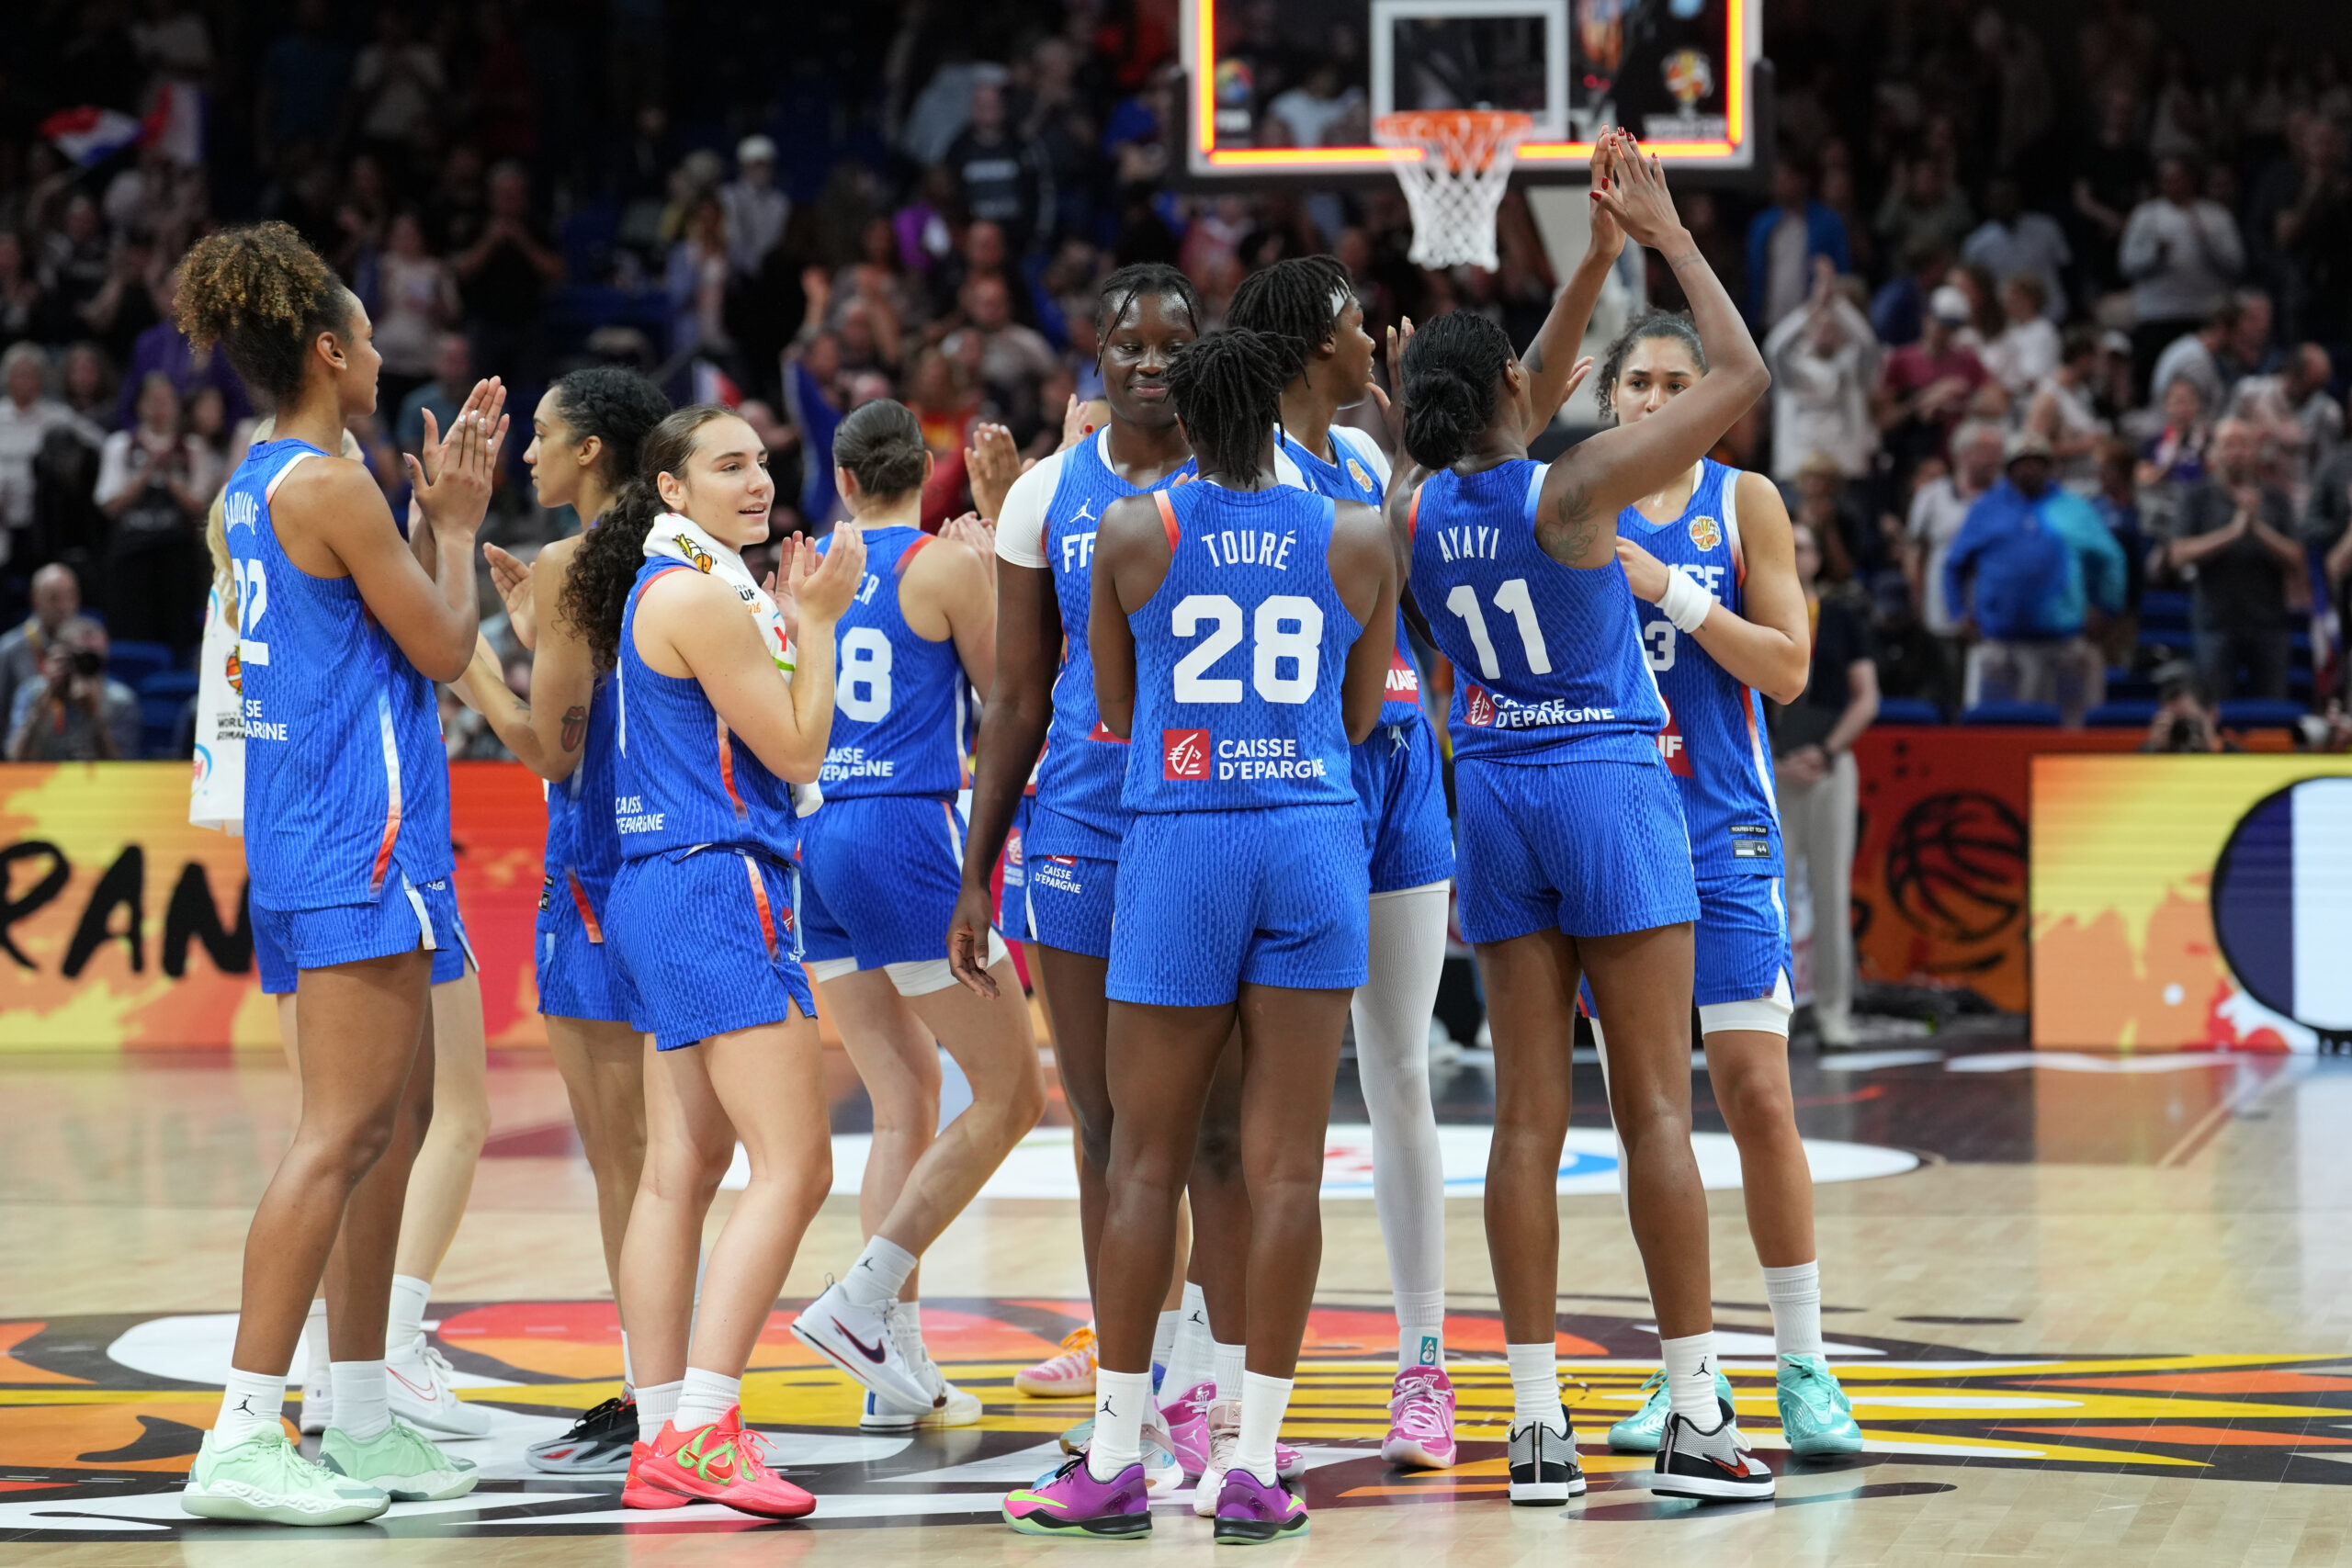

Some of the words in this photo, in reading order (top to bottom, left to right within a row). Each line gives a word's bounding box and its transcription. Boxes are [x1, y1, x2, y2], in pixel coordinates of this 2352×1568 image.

[1201, 530, 1296, 571] TOURÉ
[1438, 525, 1499, 563] AYAYI
[1446, 578, 1552, 680] 11
[1171, 594, 1324, 705] 28
[1491, 694, 1565, 713] CASSE
[1496, 707, 1615, 728] D'EPARGNE
[1218, 738, 1296, 759] CAISSE
[1219, 758, 1327, 780] D'EPARGNE
[1757, 844, 1767, 852] 44
[1035, 872, 1082, 894] D'EPARGNE
[1043, 864, 1072, 880] CAISSE
